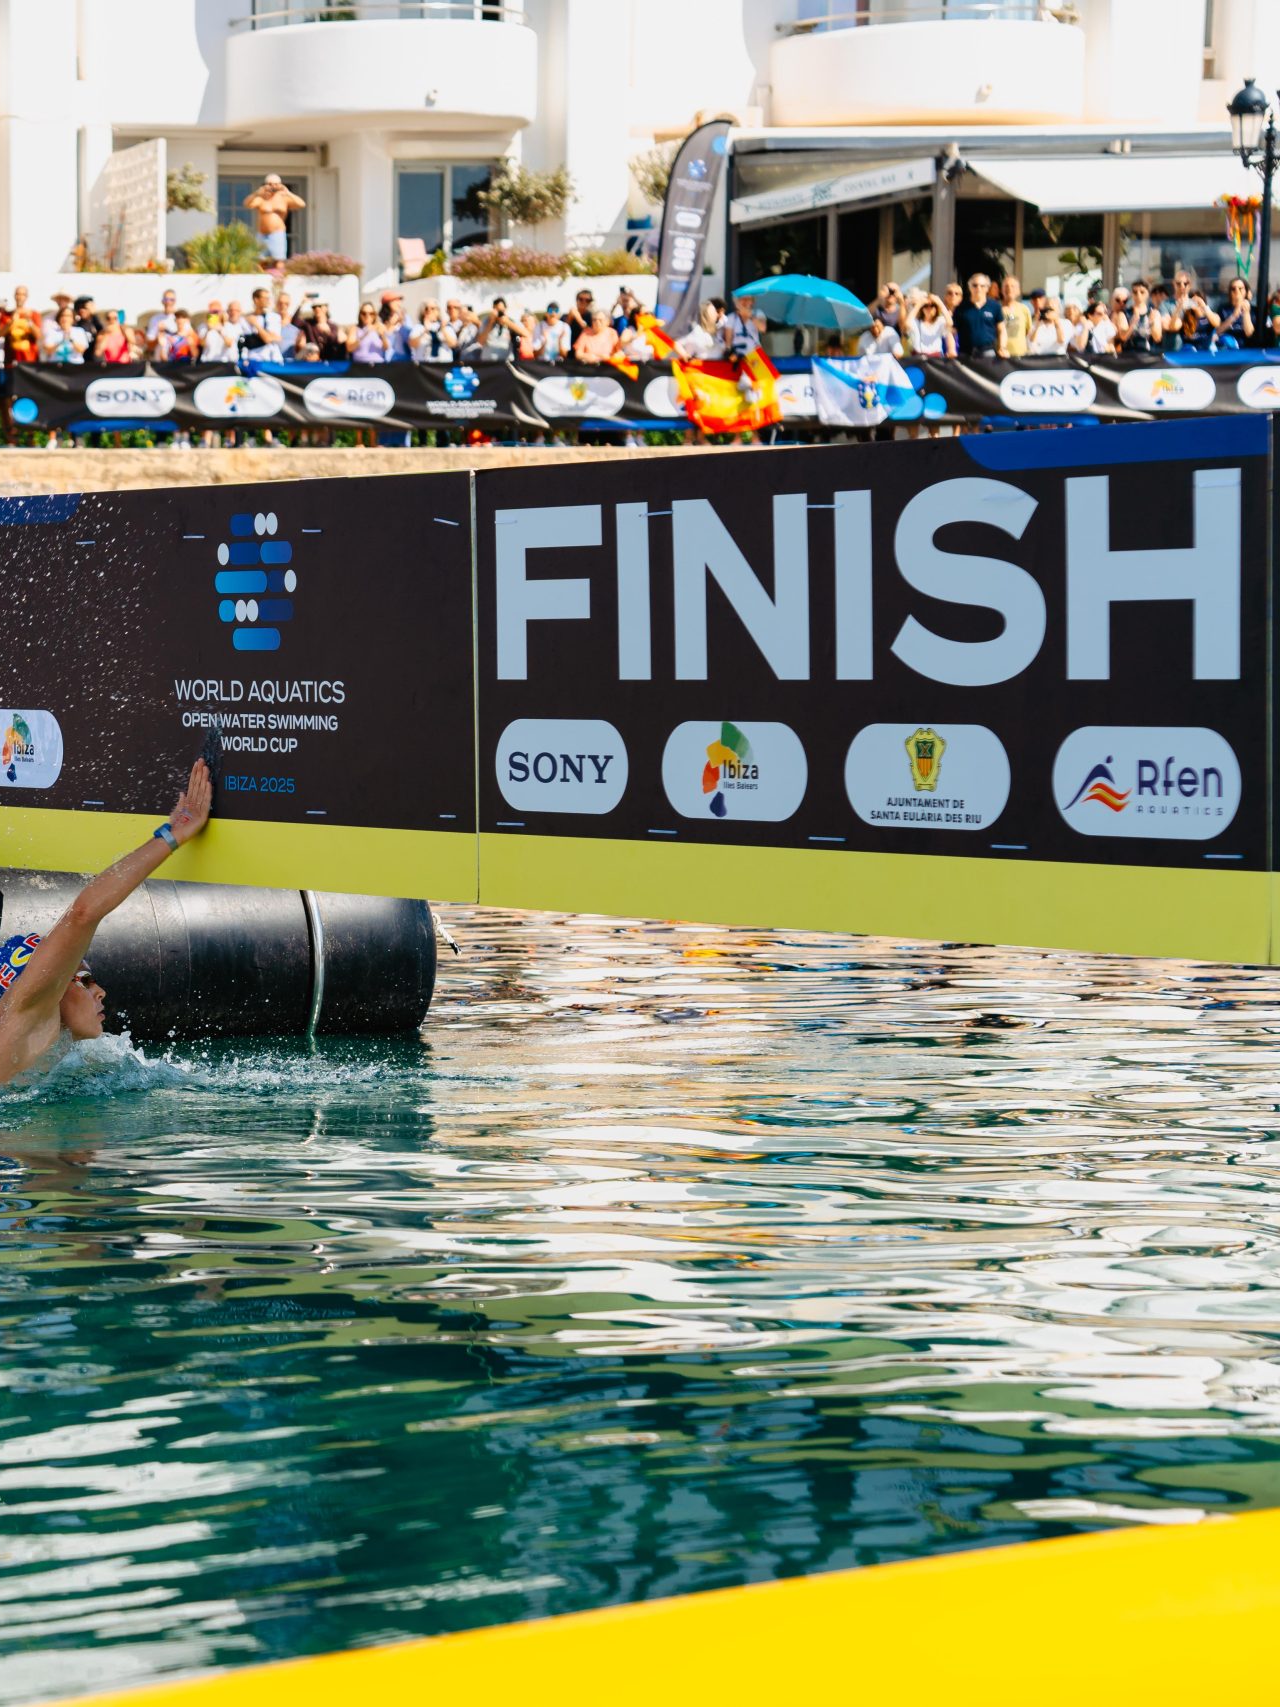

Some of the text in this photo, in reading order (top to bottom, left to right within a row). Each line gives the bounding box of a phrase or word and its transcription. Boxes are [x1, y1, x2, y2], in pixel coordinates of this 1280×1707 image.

[96, 389, 166, 403] SONY
[1011, 383, 1085, 397] SONY
[494, 467, 1242, 687] FINISH
[175, 679, 346, 704] WORLD AQUATICS
[182, 712, 339, 731] OPEN WATER SWIMMING
[13, 741, 35, 755] Ibiza
[220, 736, 298, 753] WORLD CUP
[508, 751, 614, 784] SONY
[722, 759, 759, 780] Ibiza
[224, 775, 295, 793] IBIZA 2025
[1137, 756, 1223, 798] Rfen
[886, 797, 965, 809] AJUNTAMENT DE
[870, 810, 901, 821] SANTA
[945, 813, 963, 823] DES
[965, 814, 982, 824] RIU
